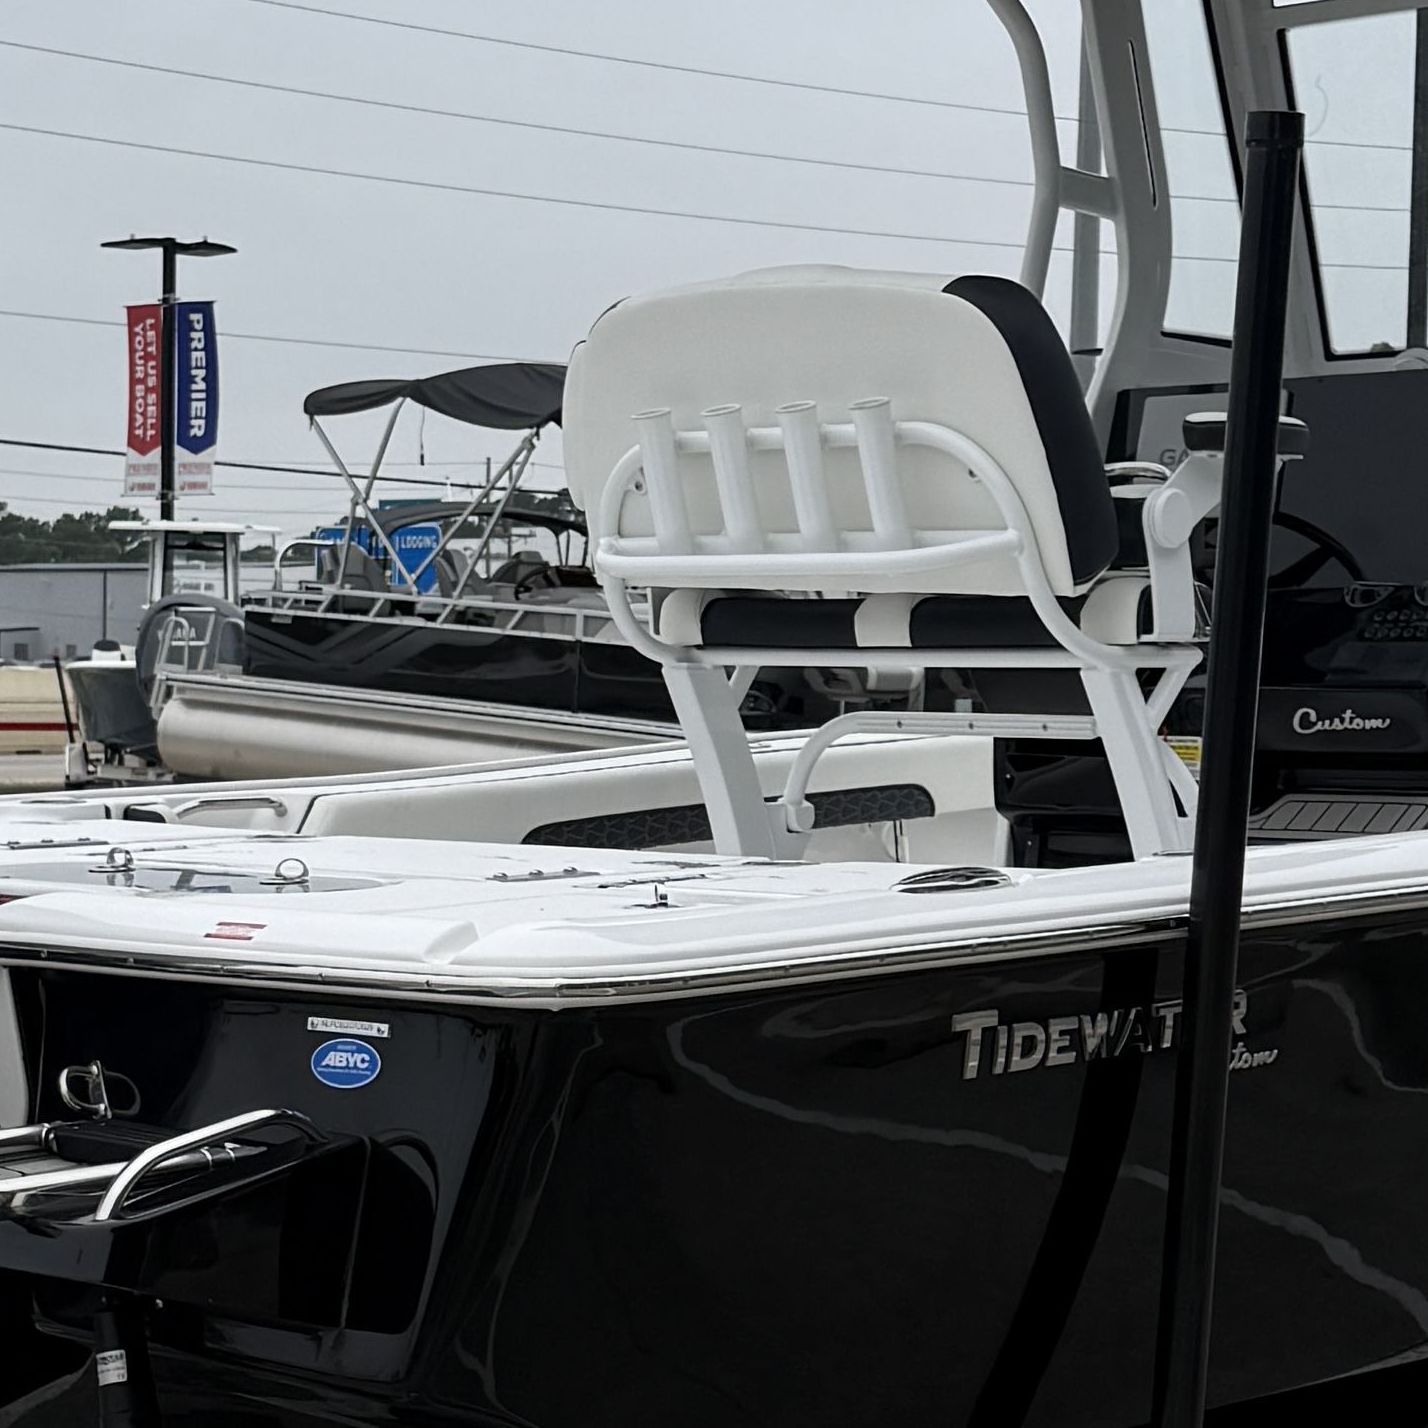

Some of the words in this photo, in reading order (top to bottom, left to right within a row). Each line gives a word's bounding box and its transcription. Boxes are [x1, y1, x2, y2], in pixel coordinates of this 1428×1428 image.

[133, 323, 145, 378] YOUR
[145, 318, 156, 355] LET
[146, 360, 157, 388] US
[188, 312, 207, 438] PREMIER
[134, 384, 145, 439] BOAT
[146, 392, 157, 442] SELL
[1293, 707, 1391, 734] Custom
[951, 988, 1248, 1080] TIDEWATR
[320, 1051, 371, 1069] ABYC
[1228, 1041, 1279, 1072] tom
